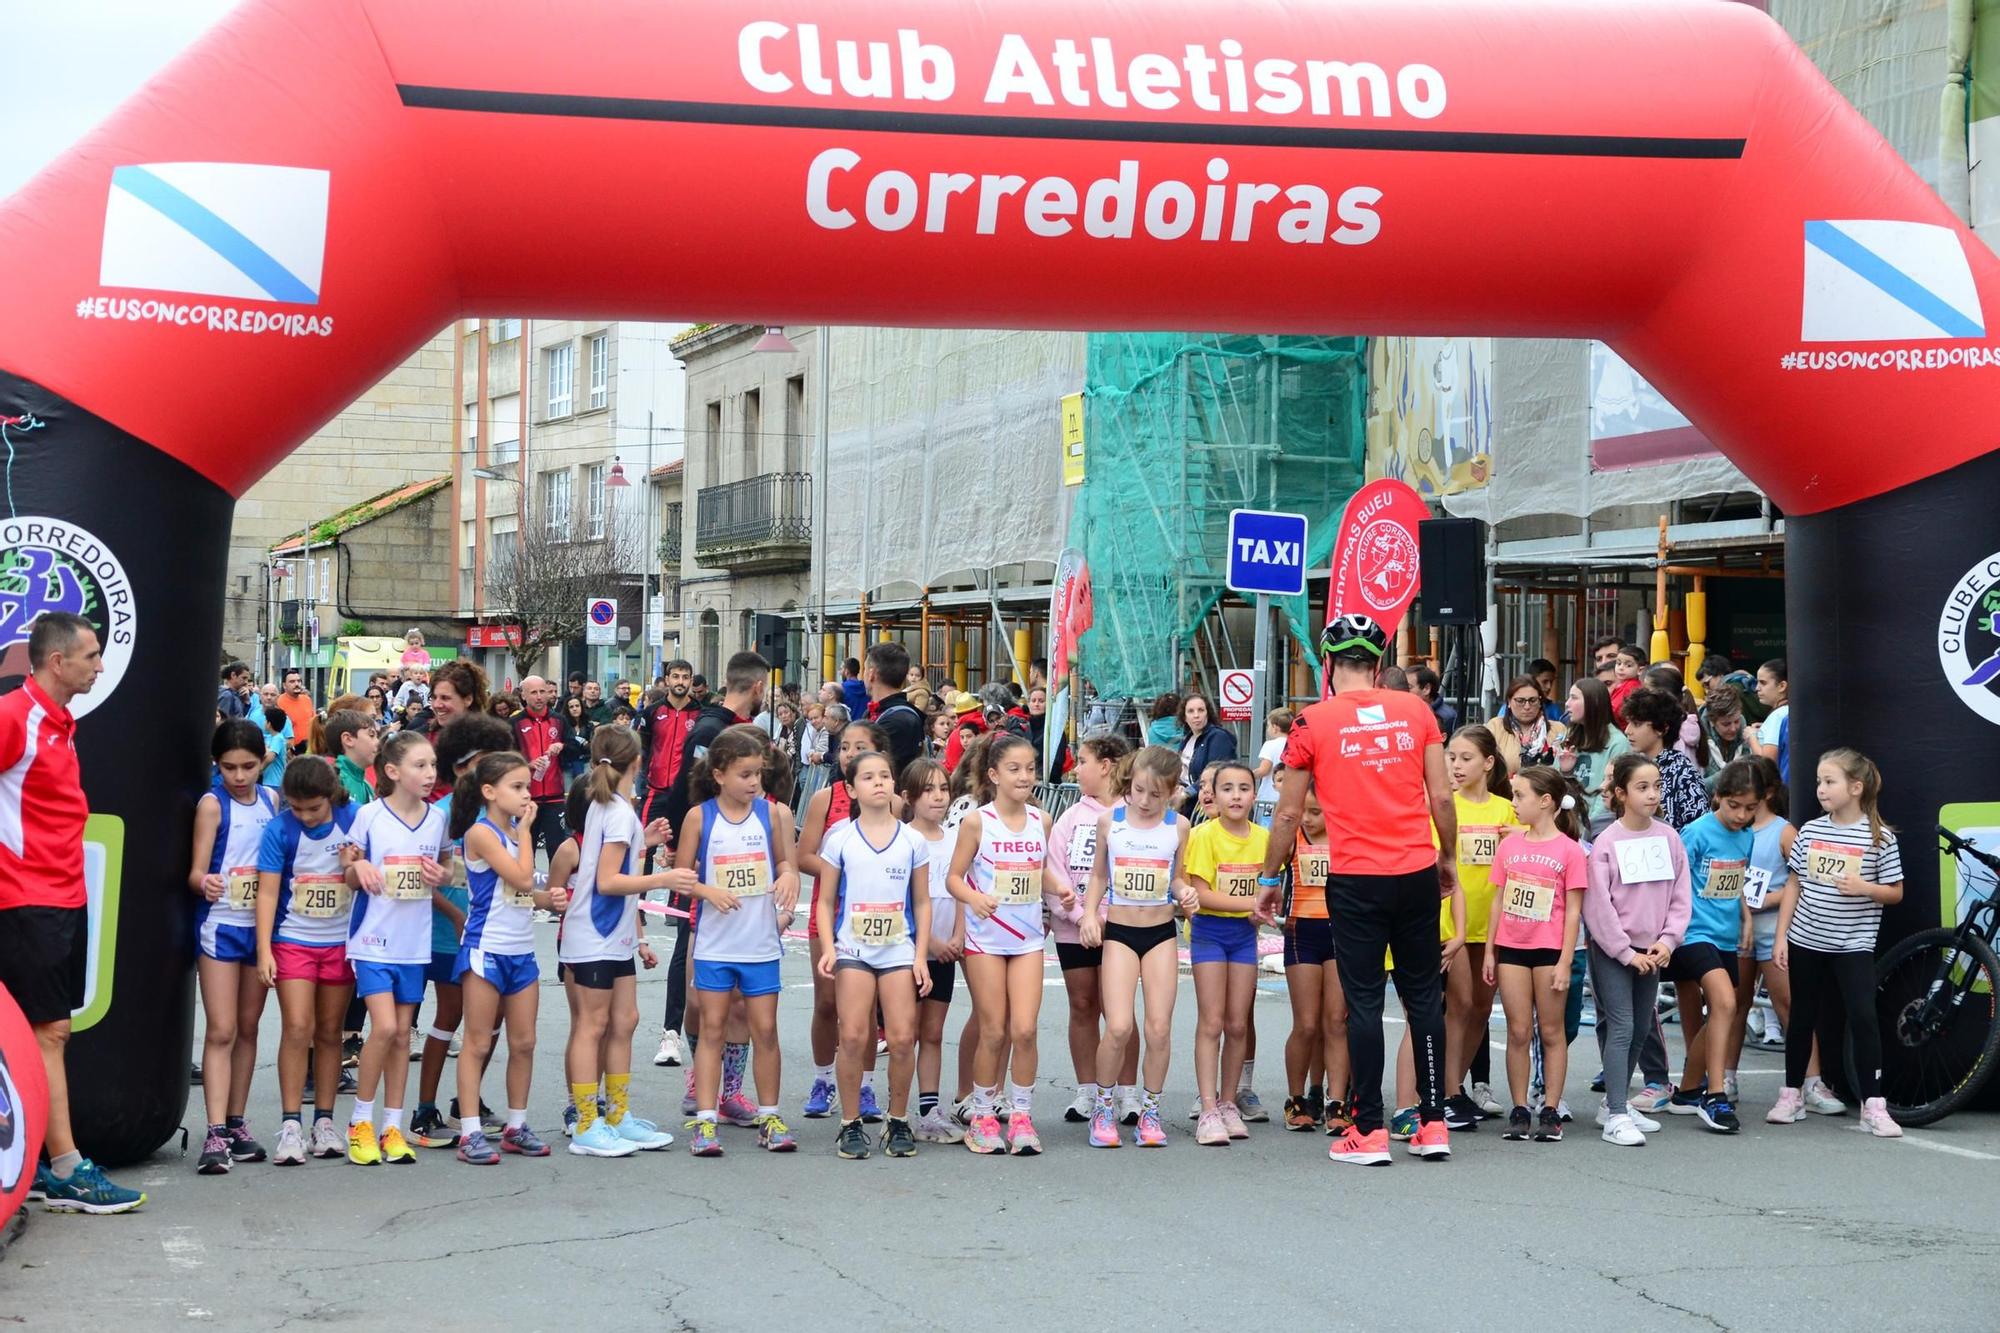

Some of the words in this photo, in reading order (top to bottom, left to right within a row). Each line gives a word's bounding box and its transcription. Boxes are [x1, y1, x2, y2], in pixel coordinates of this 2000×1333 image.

[737, 21, 956, 101] Club
[984, 34, 1448, 120] Atletismo
[805, 148, 1384, 245] Corredoiras
[76, 297, 334, 337] #EUSONCORREDOIRAS
[1357, 491, 1393, 525] BUEU
[1238, 538, 1299, 566] TAXI
[1360, 528, 1378, 561] CLUBE
[1943, 574, 1986, 654] CLUBE
[992, 841, 1042, 853] TREGA
[1474, 839, 1496, 856] 291
[1521, 854, 1529, 864] &
[1529, 854, 1564, 873] STITCH
[1622, 844, 1667, 876] 613
[1816, 856, 1846, 875] 322
[397, 871, 421, 890] 299
[726, 868, 756, 888] 295
[1011, 877, 1029, 895] 311
[1124, 872, 1155, 892] 300
[1229, 878, 1255, 896] 290
[1716, 874, 1739, 891] 320
[306, 889, 335, 908] 296
[1511, 888, 1535, 908] 319
[863, 918, 892, 937] 297
[1426, 1035, 1436, 1107] CORREDOIRAS
